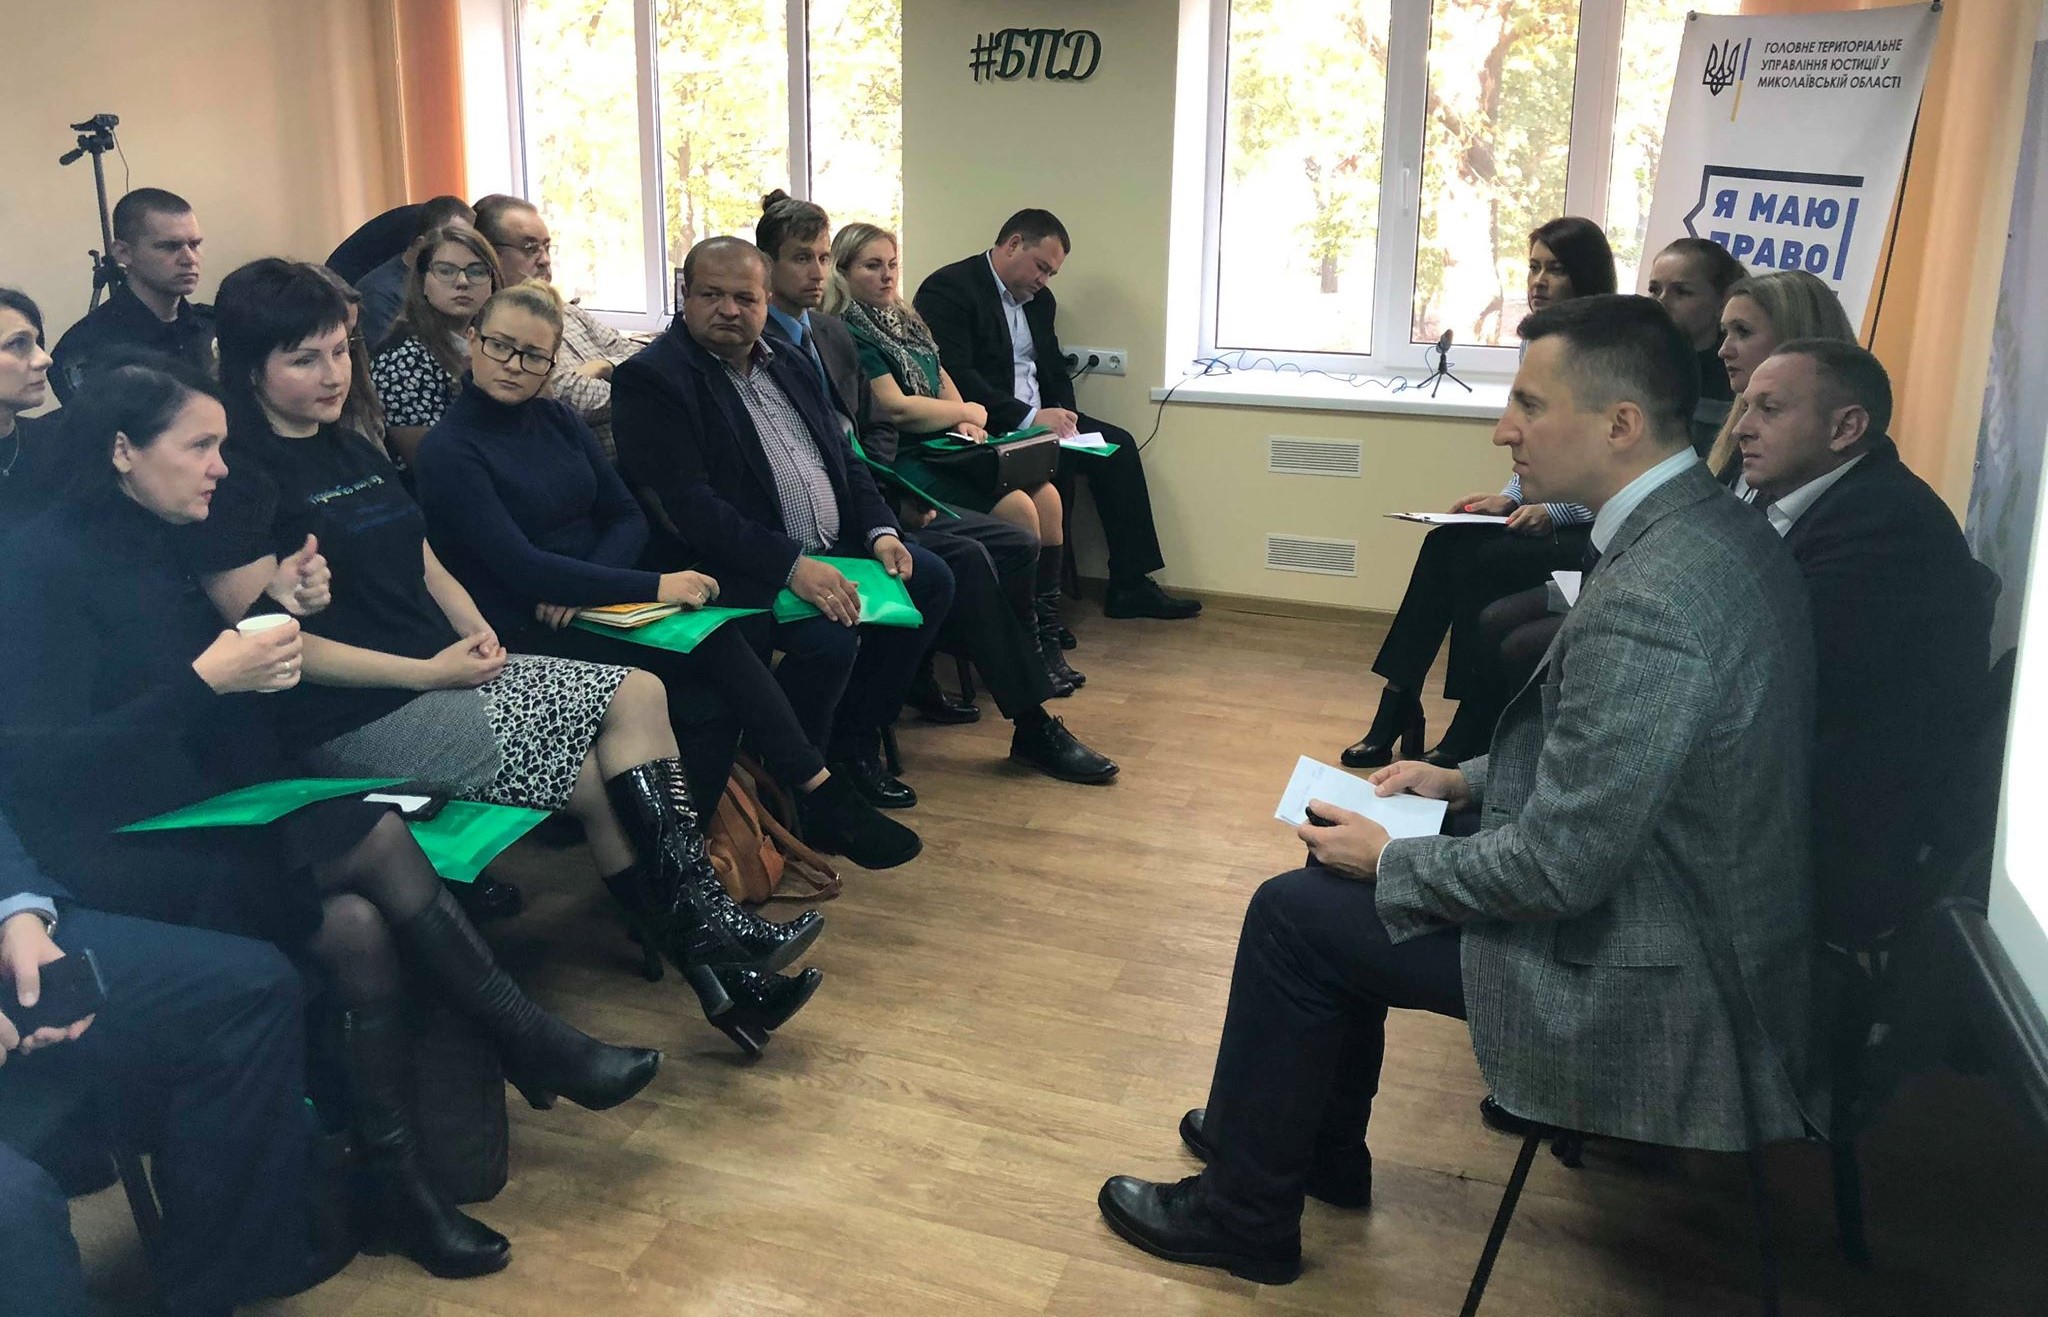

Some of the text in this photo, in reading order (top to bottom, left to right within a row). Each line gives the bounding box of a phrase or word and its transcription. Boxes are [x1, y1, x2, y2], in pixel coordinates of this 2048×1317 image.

[1764, 39, 1903, 54] ГОЛОВНЕ ТЕРИТОРІАЛЬНЕ
[1760, 55, 1890, 71] УПРАВЛІННЯ ЮСТИЦІЇ У
[1757, 74, 1902, 88] МИКОЛАЇВСЬКІЙ ОБЛАСТІ
[1712, 189, 1840, 229] Я МАЮ
